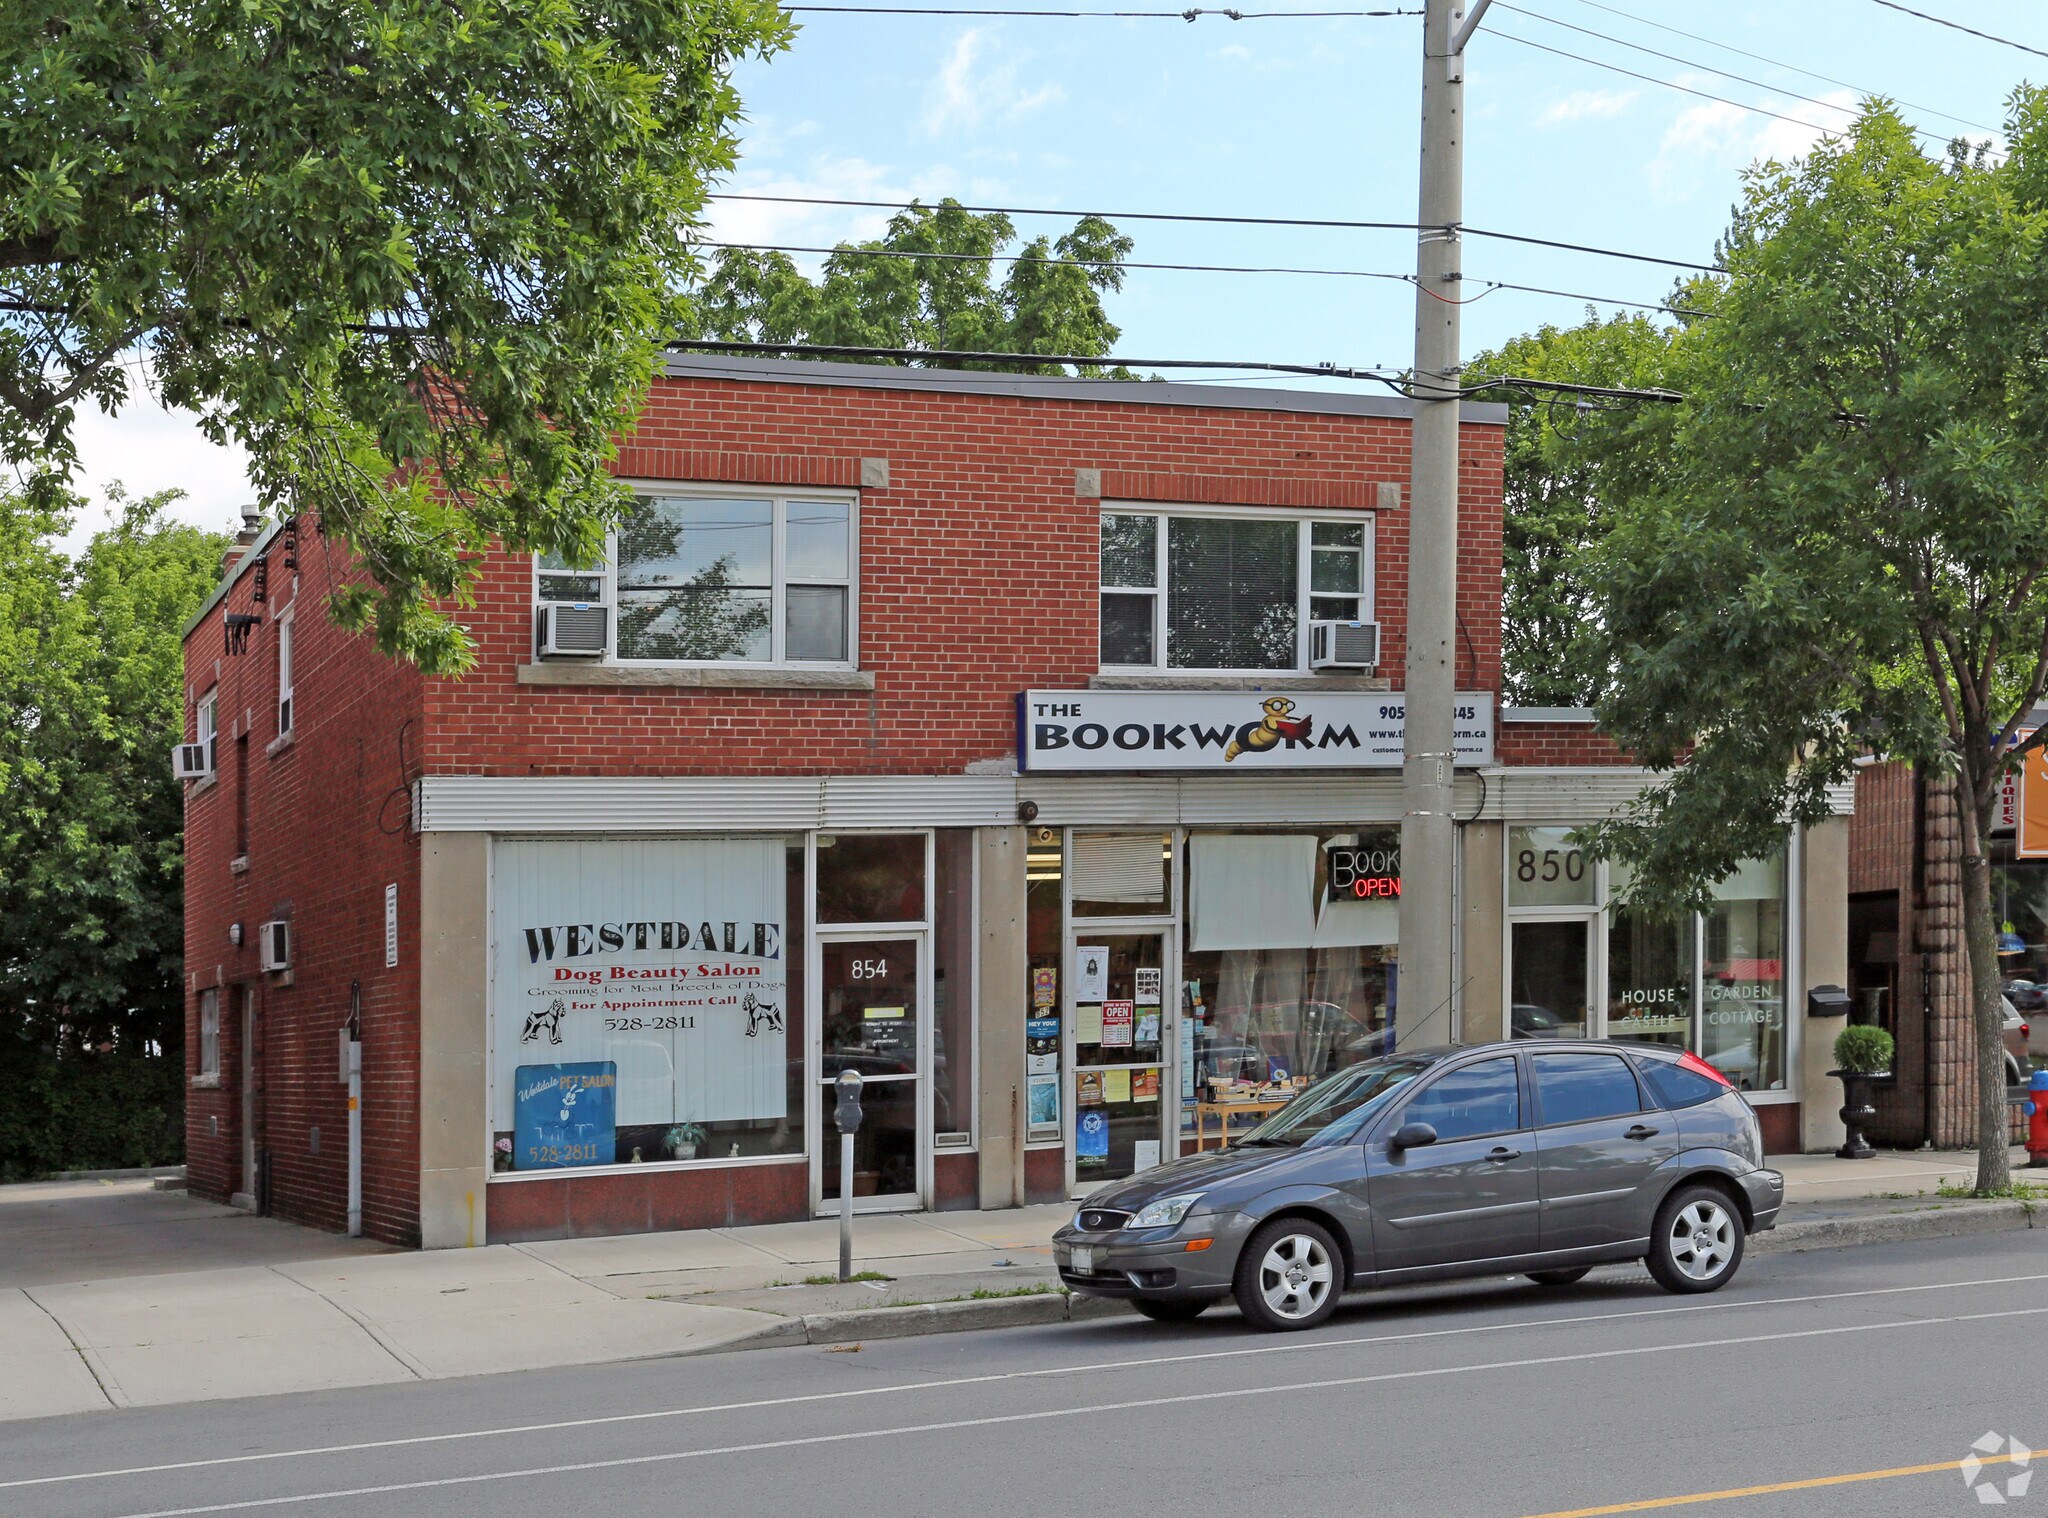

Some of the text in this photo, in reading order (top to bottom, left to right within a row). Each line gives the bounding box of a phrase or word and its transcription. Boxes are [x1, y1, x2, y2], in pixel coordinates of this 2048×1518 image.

[1033, 703, 1082, 717] THE
[1379, 706, 1405, 720] 905
[1034, 720, 1362, 753] BOOKWORM
[1517, 849, 1585, 882] 850
[1355, 877, 1402, 897] OPEN
[522, 921, 780, 964] WESTDALE
[554, 963, 761, 985] Dog Beauty Salon
[851, 958, 888, 979] 854
[527, 981, 786, 997] Grooming for Most Breeds of Dogs
[1621, 985, 1772, 1004] HOUSE GARDEN
[571, 996, 737, 1012] For Appointment Call
[1106, 1007, 1129, 1017] OPEN
[604, 1016, 696, 1032] 528-2811
[1621, 1009, 1773, 1030] CASTLE COTTAGE
[517, 1074, 615, 1102] Westdale PET SALON
[529, 1143, 599, 1163] 528-2811
